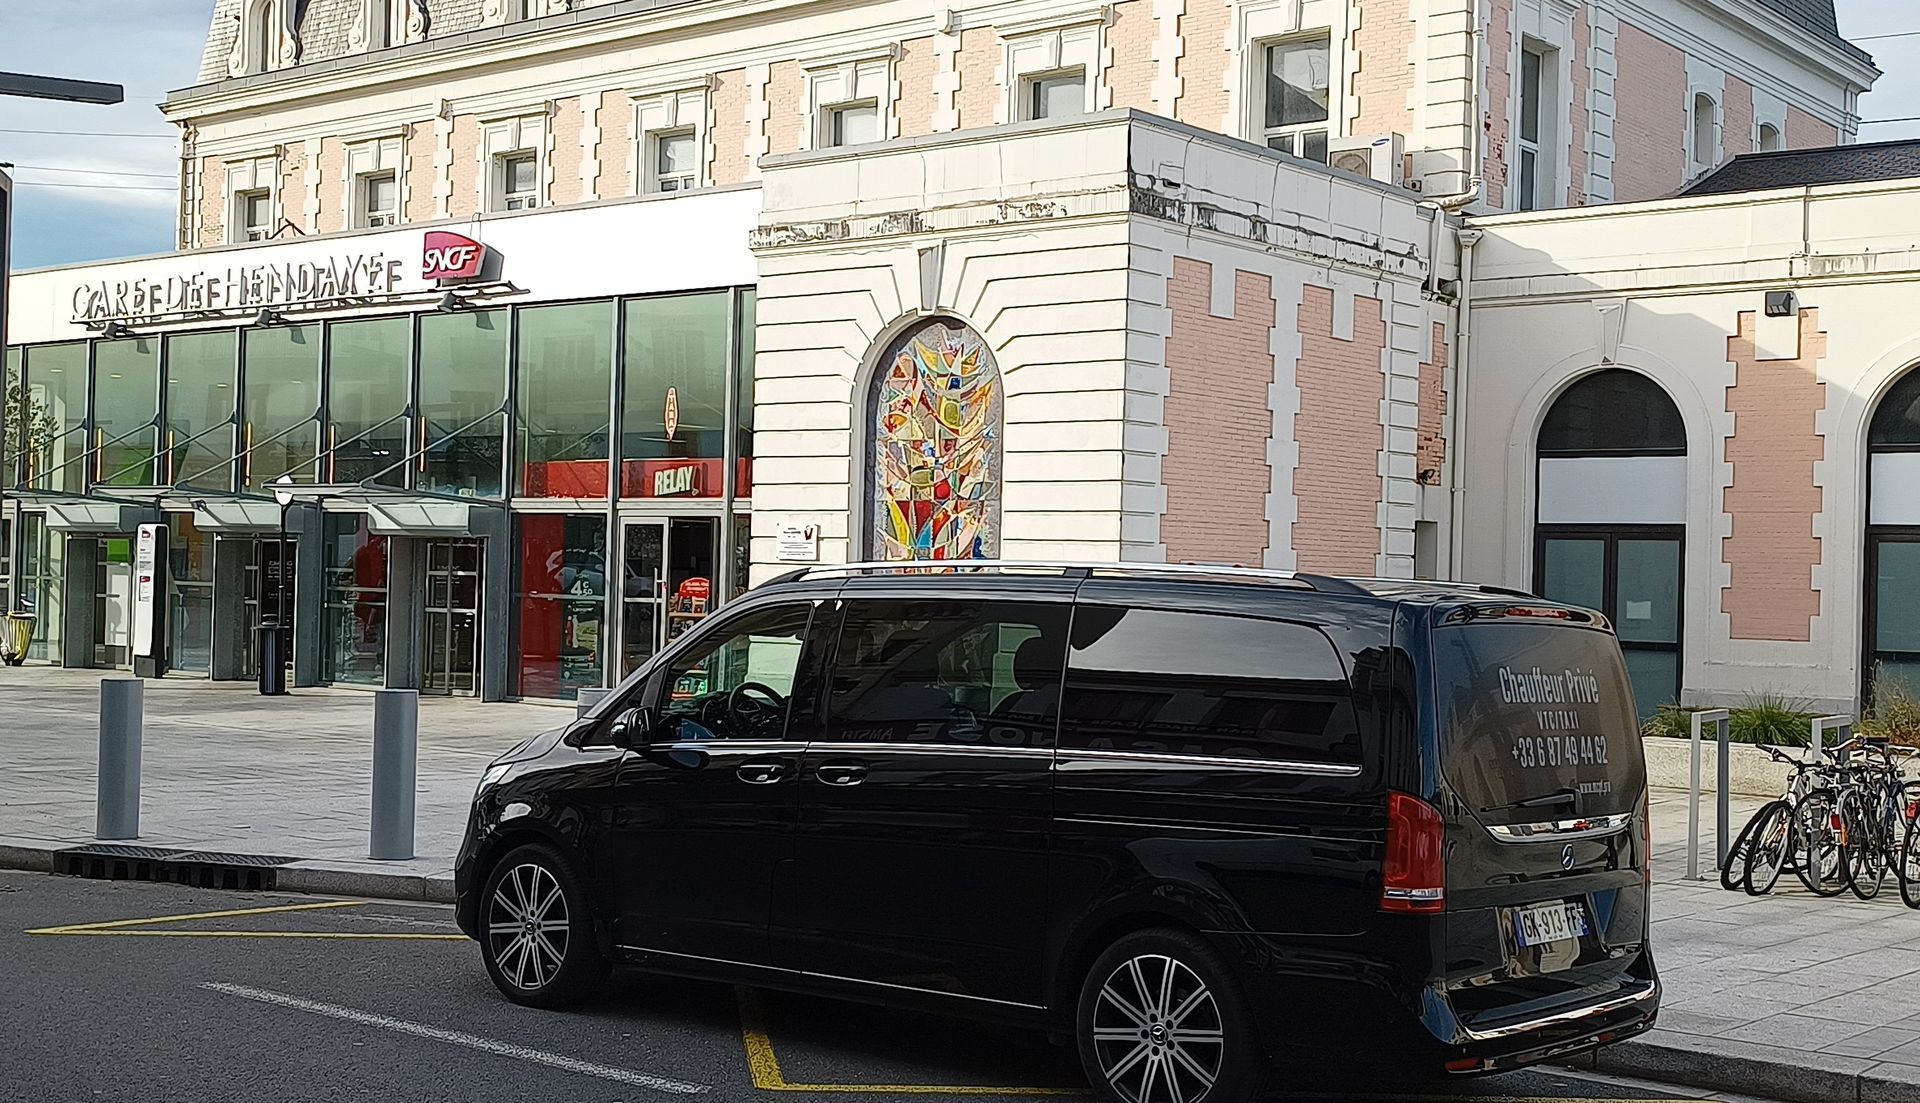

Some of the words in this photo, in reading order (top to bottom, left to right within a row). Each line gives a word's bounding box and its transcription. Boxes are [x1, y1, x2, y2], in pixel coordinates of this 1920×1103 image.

[423, 246, 477, 273] SNCF
[72, 277, 148, 320] GARE
[225, 251, 385, 308] HENDAYE
[654, 465, 694, 496] RELAY
[1499, 666, 1565, 704] Chauffeur
[1565, 668, 1599, 704] Privé
[1512, 736, 1535, 768] +33
[1536, 736, 1546, 767] 6
[1564, 735, 1578, 766] 49
[1580, 735, 1594, 765] 44
[1594, 734, 1609, 764] 62
